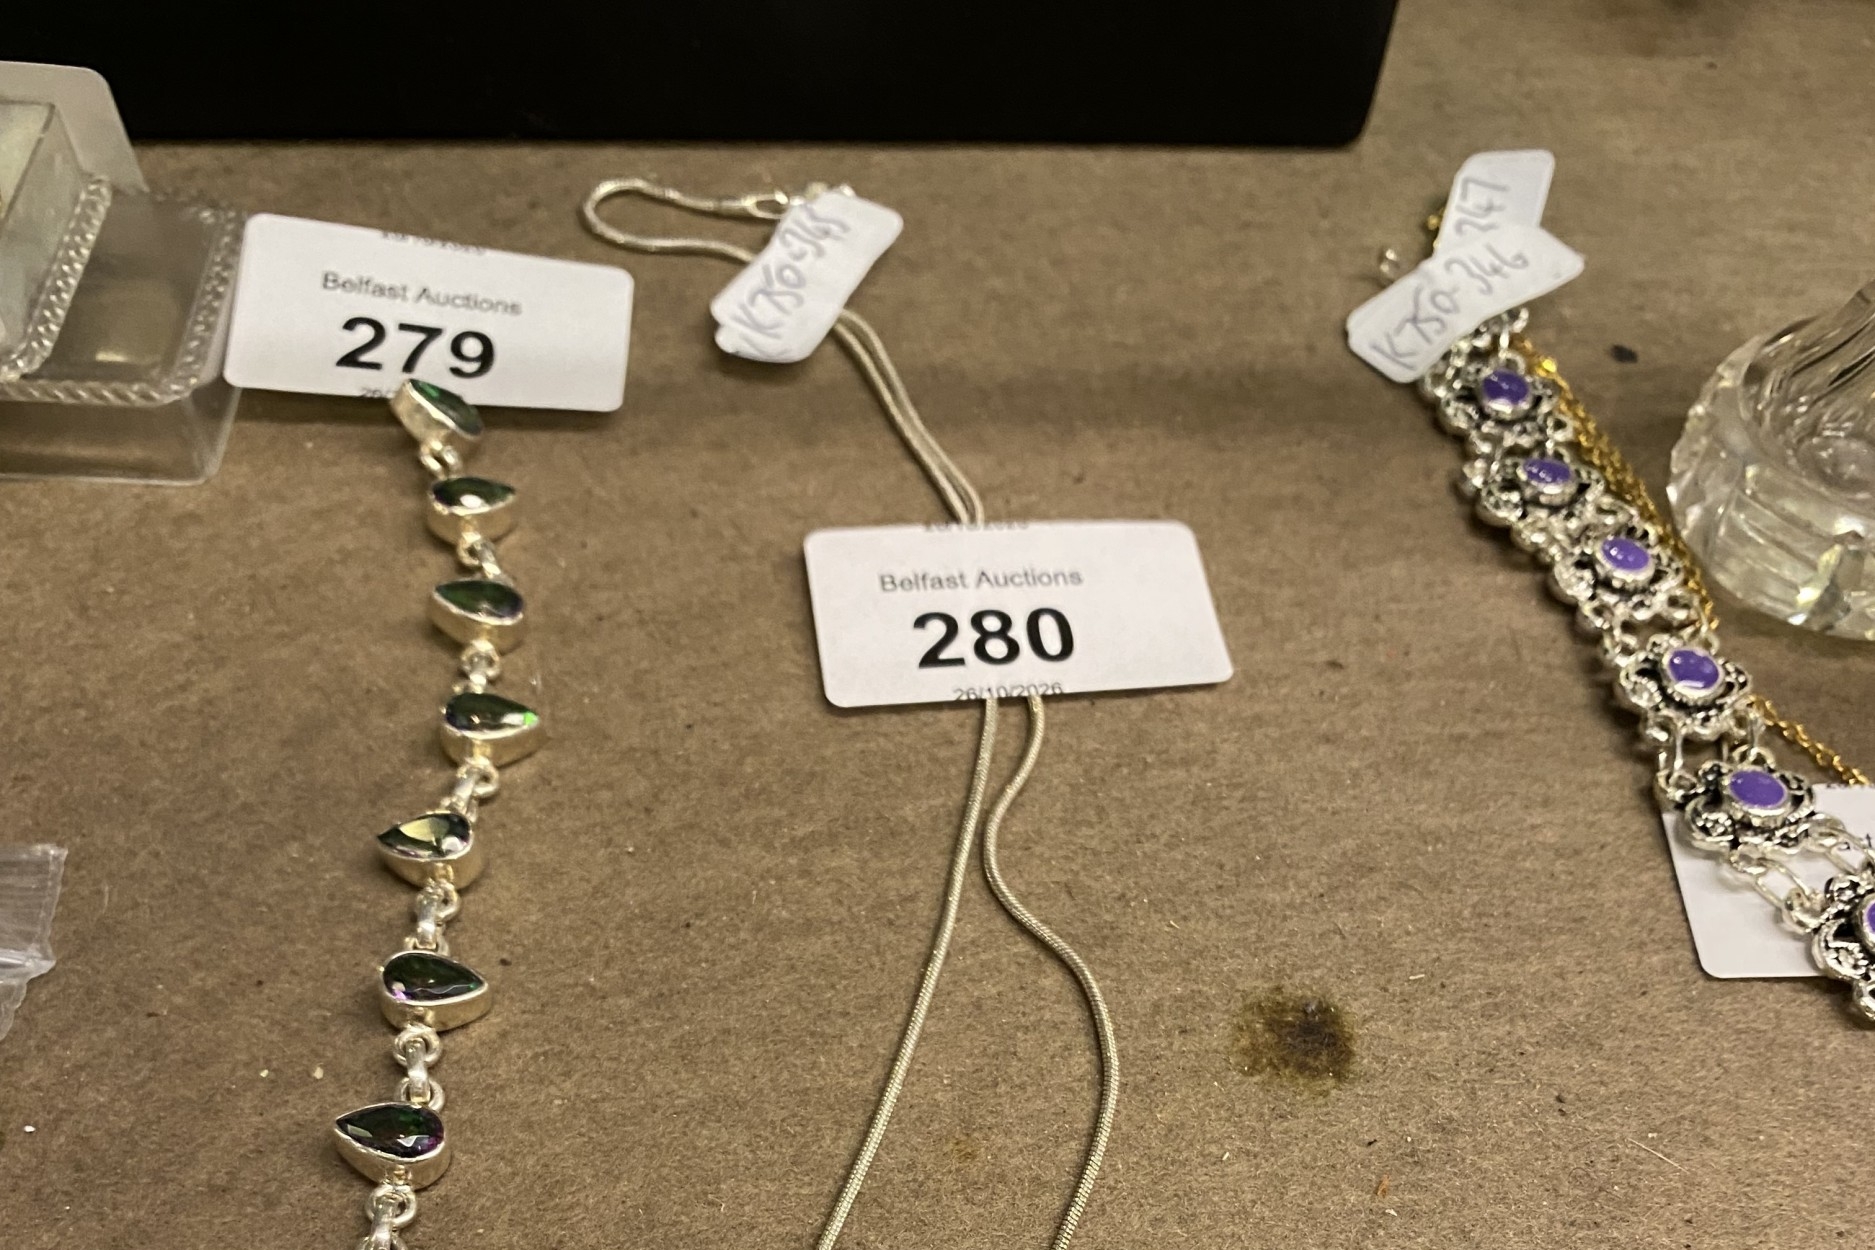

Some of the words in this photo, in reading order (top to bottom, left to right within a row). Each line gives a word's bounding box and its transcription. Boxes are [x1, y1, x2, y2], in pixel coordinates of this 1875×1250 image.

[322, 270, 408, 301] Belfast
[415, 284, 522, 316] Auctions
[335, 316, 495, 379] 279
[878, 571, 966, 593] Belfast
[975, 567, 1084, 590] Auctions
[912, 606, 1075, 670] 280
